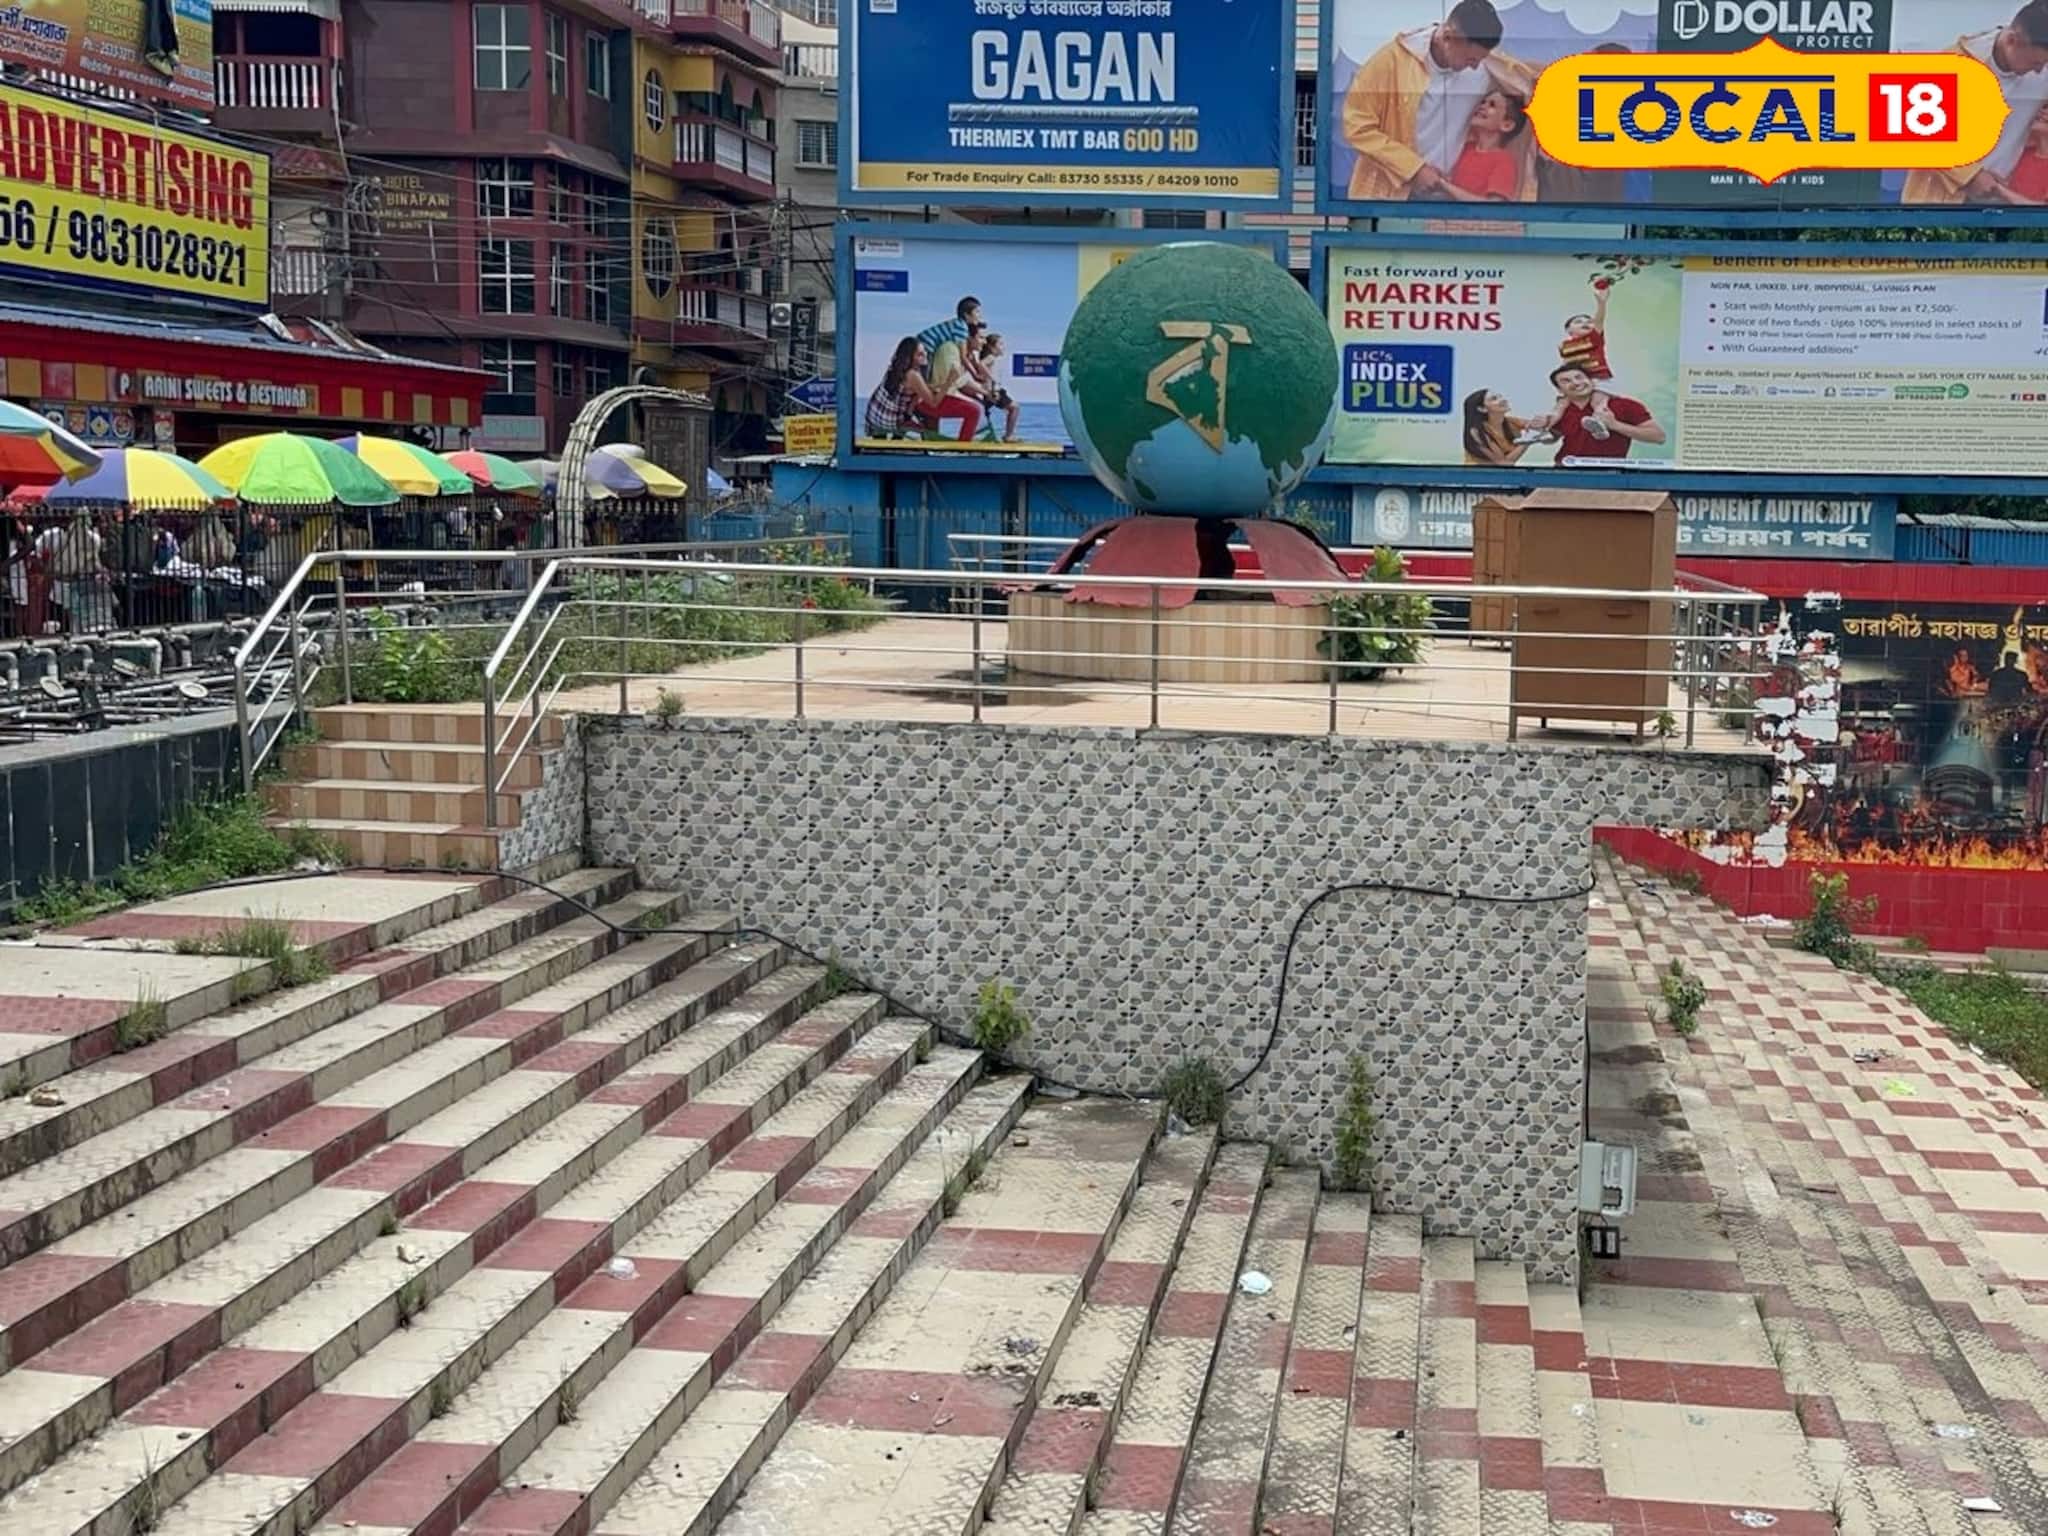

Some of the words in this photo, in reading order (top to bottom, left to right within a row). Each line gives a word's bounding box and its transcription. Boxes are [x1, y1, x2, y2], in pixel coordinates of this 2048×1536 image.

[1714, 0, 1874, 34] DOLLAR
[1796, 35, 1874, 48] PROTECT
[972, 30, 1175, 101] GAGAN
[949, 128, 1035, 148] THERMEX
[1040, 130, 1078, 149] TMT
[1084, 131, 1120, 150] BAR
[1123, 128, 1164, 152] 600
[1169, 129, 1199, 152] HD
[0, 99, 253, 231] ADVERTISING
[906, 172, 929, 183] For
[933, 172, 969, 183] Trade
[973, 172, 1024, 186] Enquiry
[1027, 173, 1056, 184] Call:
[1059, 174, 1100, 184] 83730
[1104, 174, 1144, 185] 55335
[1157, 175, 1200, 186] 84209
[1204, 176, 1239, 187] 10110
[1711, 175, 1734, 184] MAN
[1801, 175, 1825, 185] KIDS
[45, 205, 59, 254] /
[69, 210, 246, 287] 9831028321
[1344, 266, 1378, 277] Fast
[1386, 266, 1458, 278] forward
[1465, 270, 1505, 281] your
[1345, 282, 1504, 304] MARKET
[1872, 284, 1910, 292] SAVINGS
[1913, 284, 1936, 292] PLAN
[1724, 302, 1746, 311] Start
[1750, 303, 1772, 312] with
[1774, 303, 1815, 314] Monthly
[1818, 304, 1862, 314] premium
[1879, 304, 1898, 313] low
[1345, 310, 1502, 331] RETURNS
[1723, 317, 1755, 326] Choice
[1793, 318, 1821, 327] funds
[1859, 319, 1887, 328] 100%
[1890, 319, 1931, 329] invested
[1353, 351, 1393, 361] LIC's
[1722, 344, 1745, 352] With
[1747, 345, 1805, 353] Guaranteed
[1352, 362, 1426, 382] INDEX
[120, 373, 130, 396] P
[185, 379, 233, 402] SWEETS
[236, 382, 247, 403] &
[1352, 382, 1442, 408] PLUS
[1420, 491, 1480, 514] TARAP
[1678, 498, 1762, 521] LOPMENT
[1765, 500, 1872, 525] AUTHORITY
[1843, 613, 1923, 638] তারাপীঠ
[1928, 620, 1998, 641] মহাযজ্ঞ
